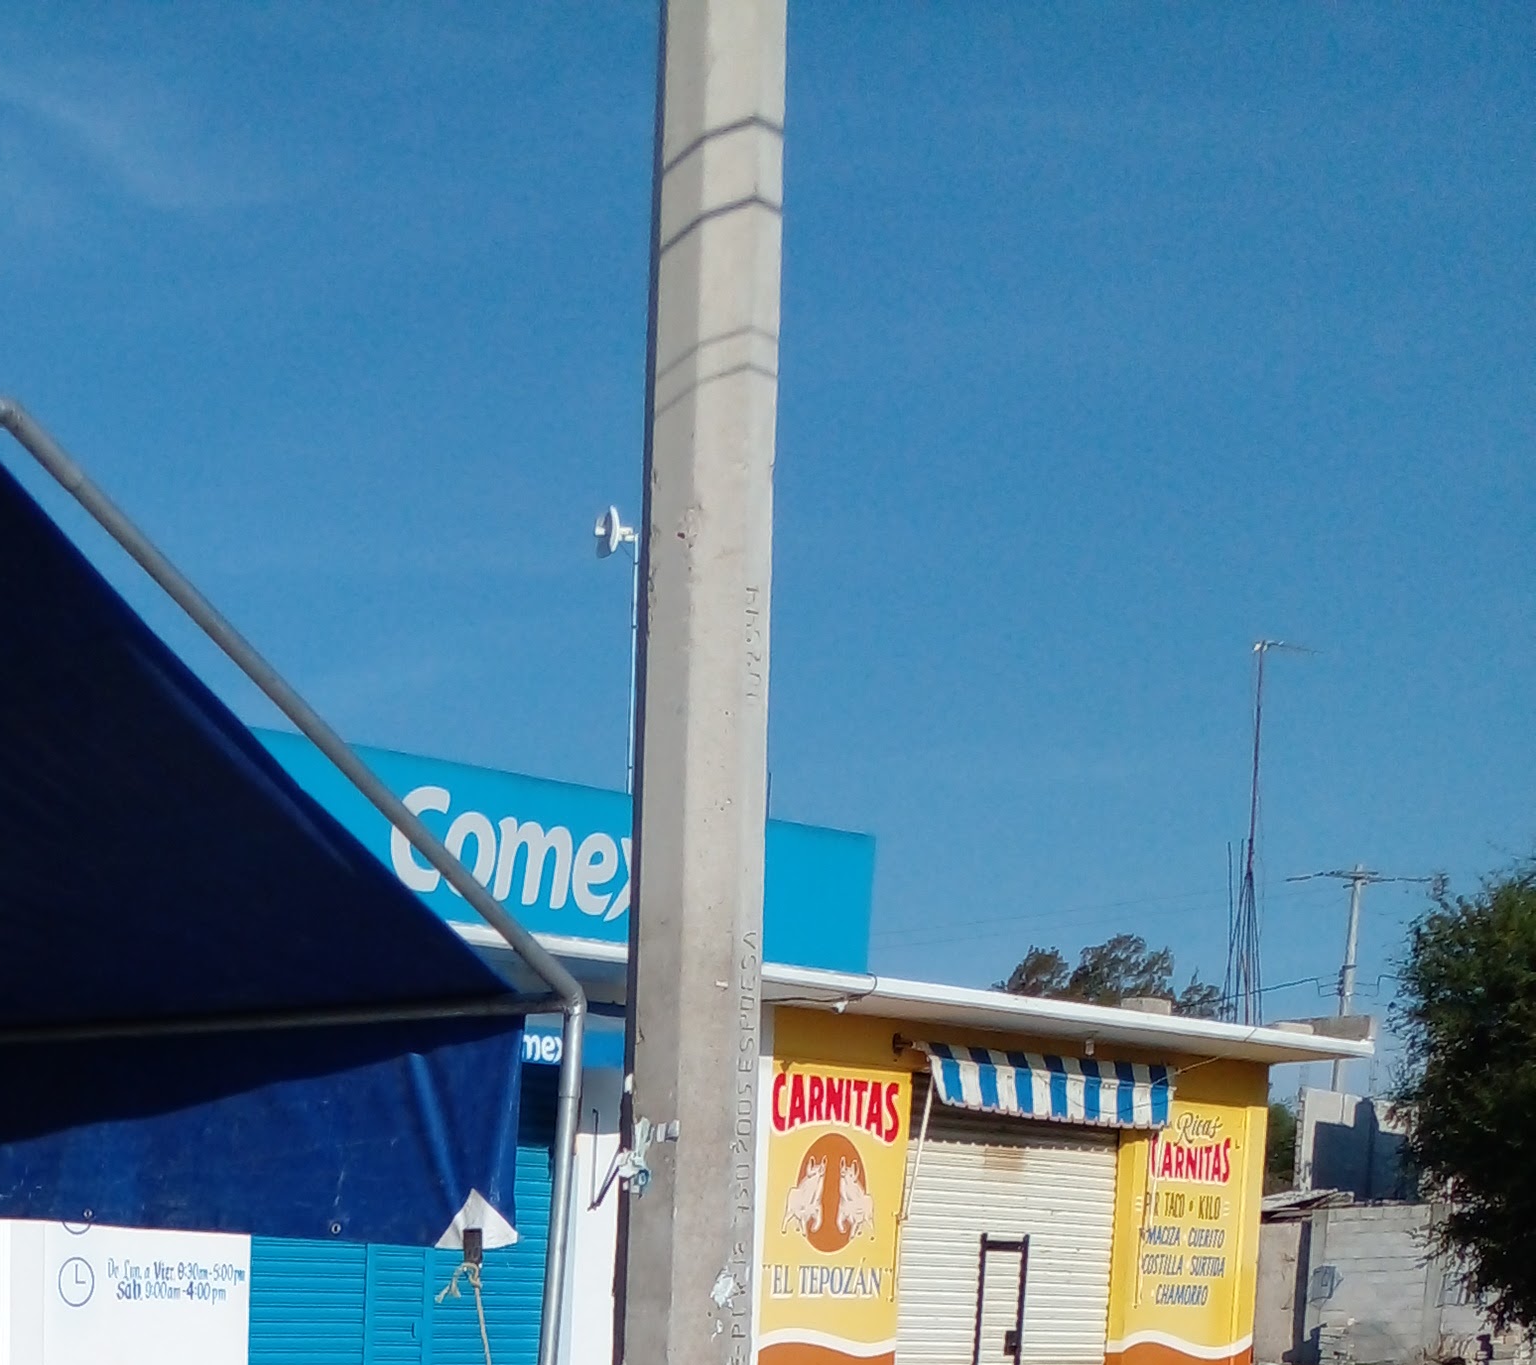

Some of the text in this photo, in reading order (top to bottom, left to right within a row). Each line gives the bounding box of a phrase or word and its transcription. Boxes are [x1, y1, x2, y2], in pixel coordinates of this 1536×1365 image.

[772, 1072, 900, 1143] CARNITAS
[1174, 1112, 1223, 1146] Ricas
[1151, 1132, 1232, 1184] CARNITAS
[1144, 1191, 1160, 1218] PR
[1164, 1191, 1185, 1218] TACO
[1198, 1195, 1221, 1221] KILO
[1146, 1225, 1225, 1248] MACIZA CUERITO
[1141, 1253, 1226, 1278] COSTILLA SURTIDA
[1155, 1283, 1209, 1306] CHAMORRO
